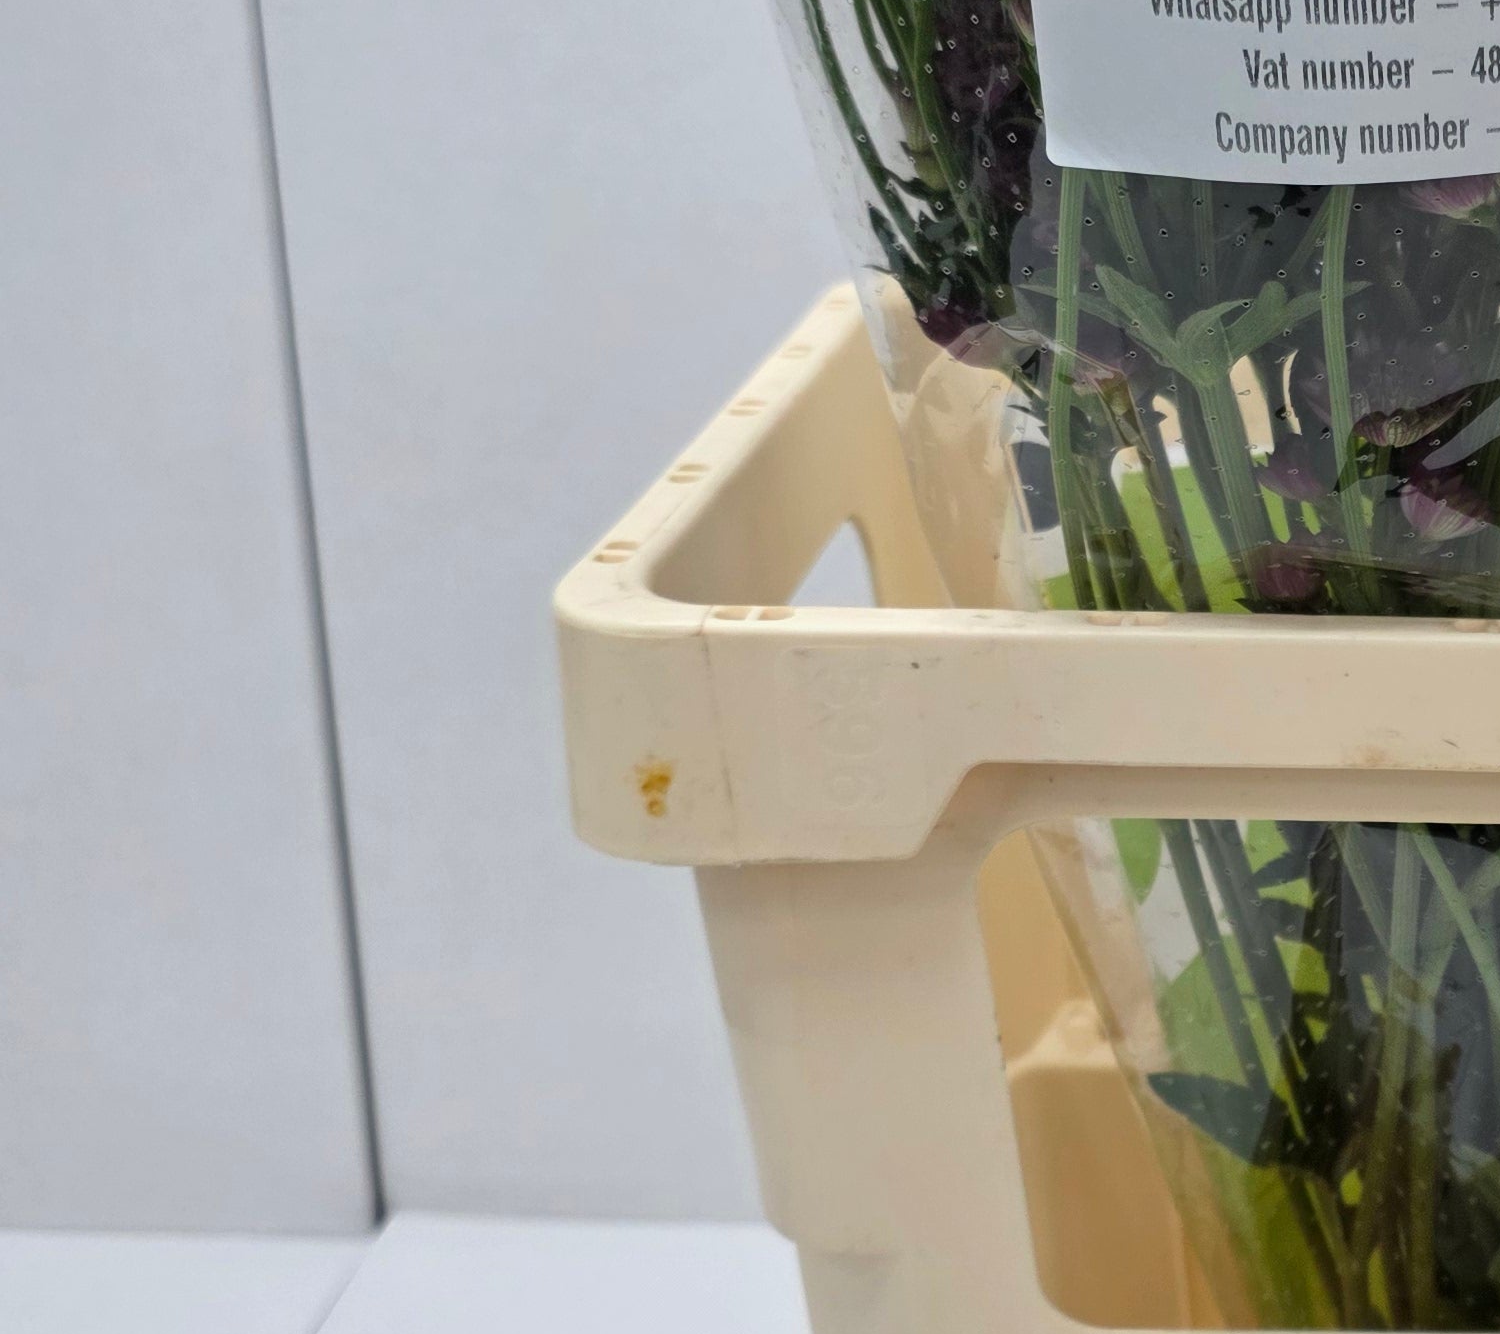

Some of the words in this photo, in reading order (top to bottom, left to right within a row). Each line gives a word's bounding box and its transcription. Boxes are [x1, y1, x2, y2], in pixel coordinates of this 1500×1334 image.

[1243, 49, 1289, 90] Vat
[1302, 51, 1414, 90] number
[1216, 112, 1347, 164] Company
[1360, 113, 1469, 154] number
